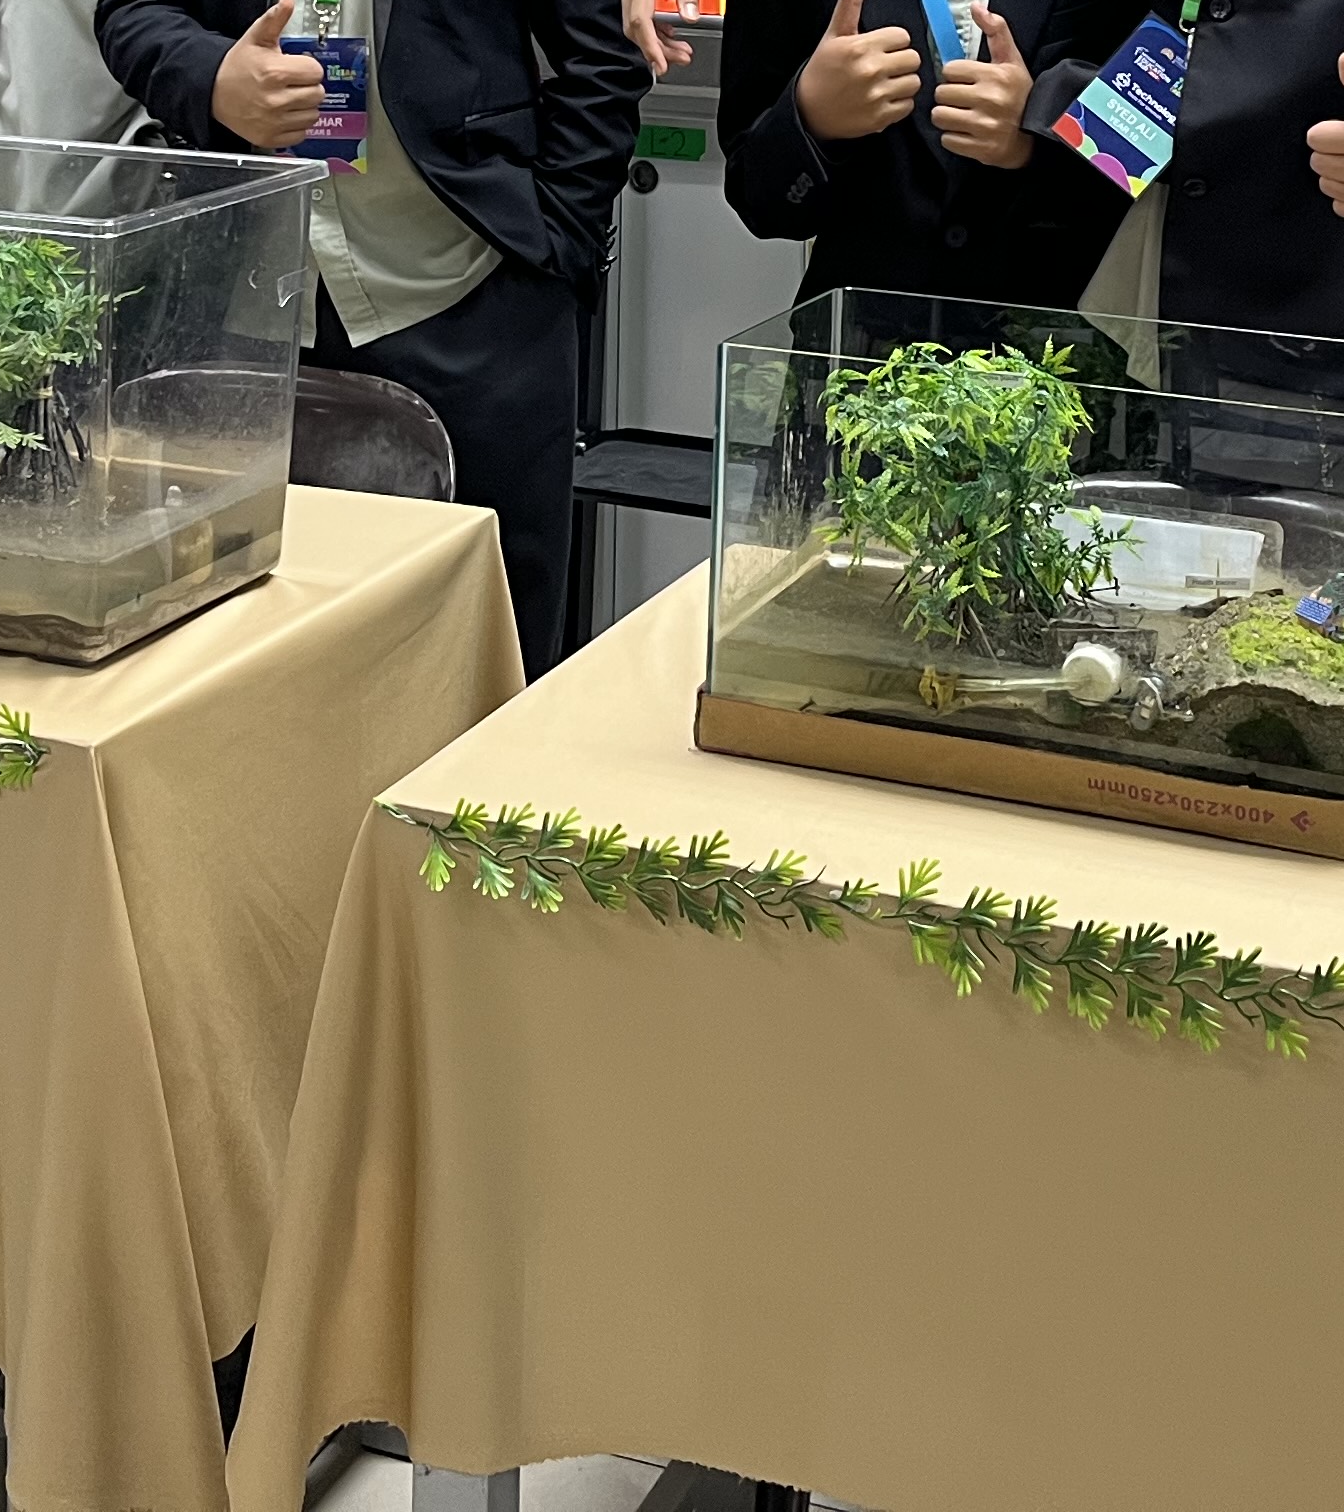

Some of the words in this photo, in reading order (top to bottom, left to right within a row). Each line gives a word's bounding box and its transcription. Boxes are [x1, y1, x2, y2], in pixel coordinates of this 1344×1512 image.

[1106, 98, 1138, 125] SYED
[1136, 122, 1157, 141] ALI
[1109, 114, 1130, 134] YEAR
[1087, 777, 1275, 824] 400x230x250mm
